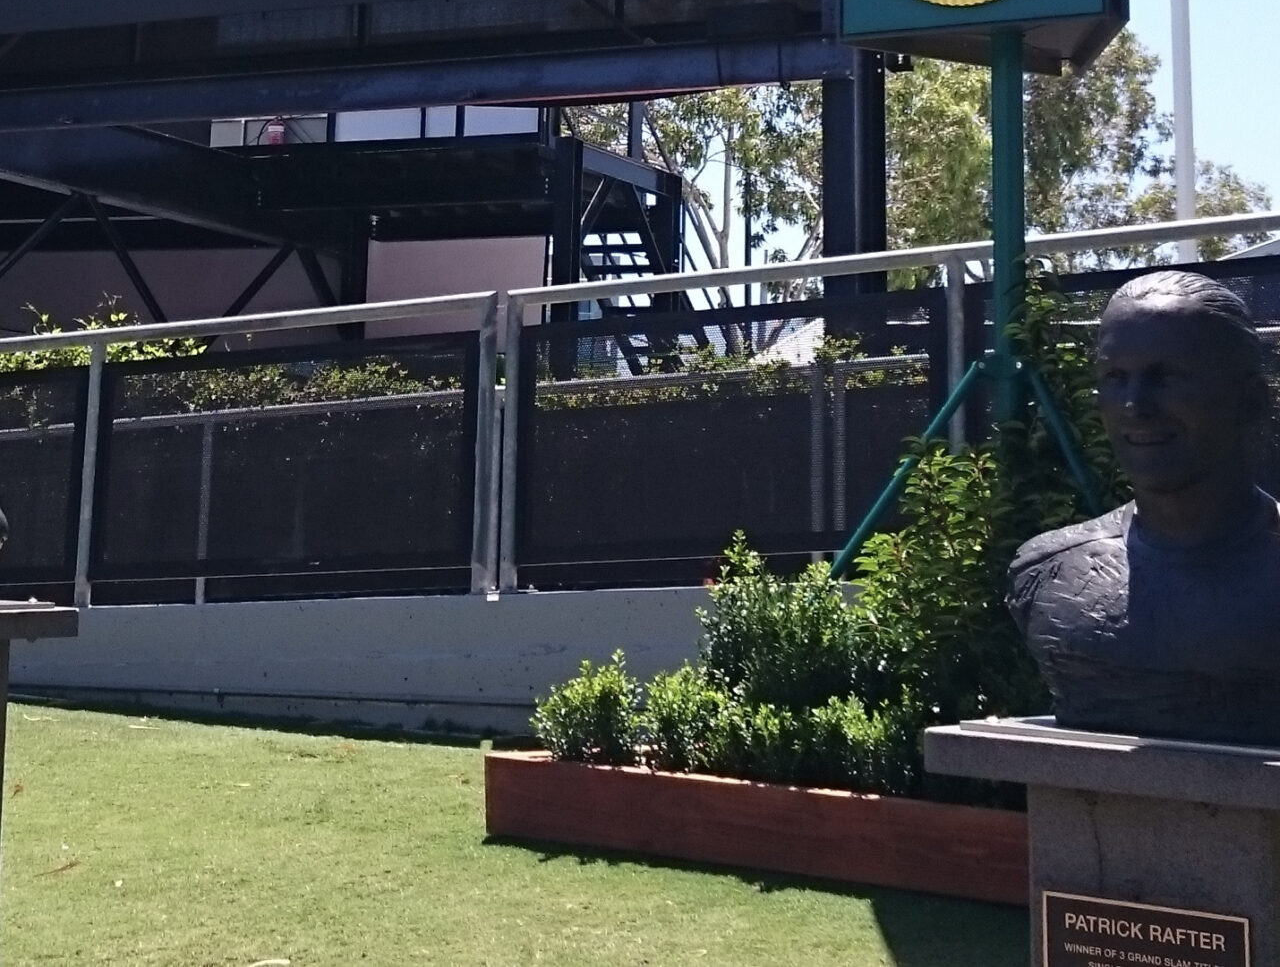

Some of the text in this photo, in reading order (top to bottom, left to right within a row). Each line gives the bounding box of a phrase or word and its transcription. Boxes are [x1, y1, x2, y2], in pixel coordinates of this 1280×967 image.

[1064, 912, 1227, 952] PATRICK RAFTER
[1064, 942, 1102, 957] WINNER
[1104, 948, 1118, 959] OF
[1119, 951, 1126, 961] 3
[1127, 952, 1163, 966] GRAND
